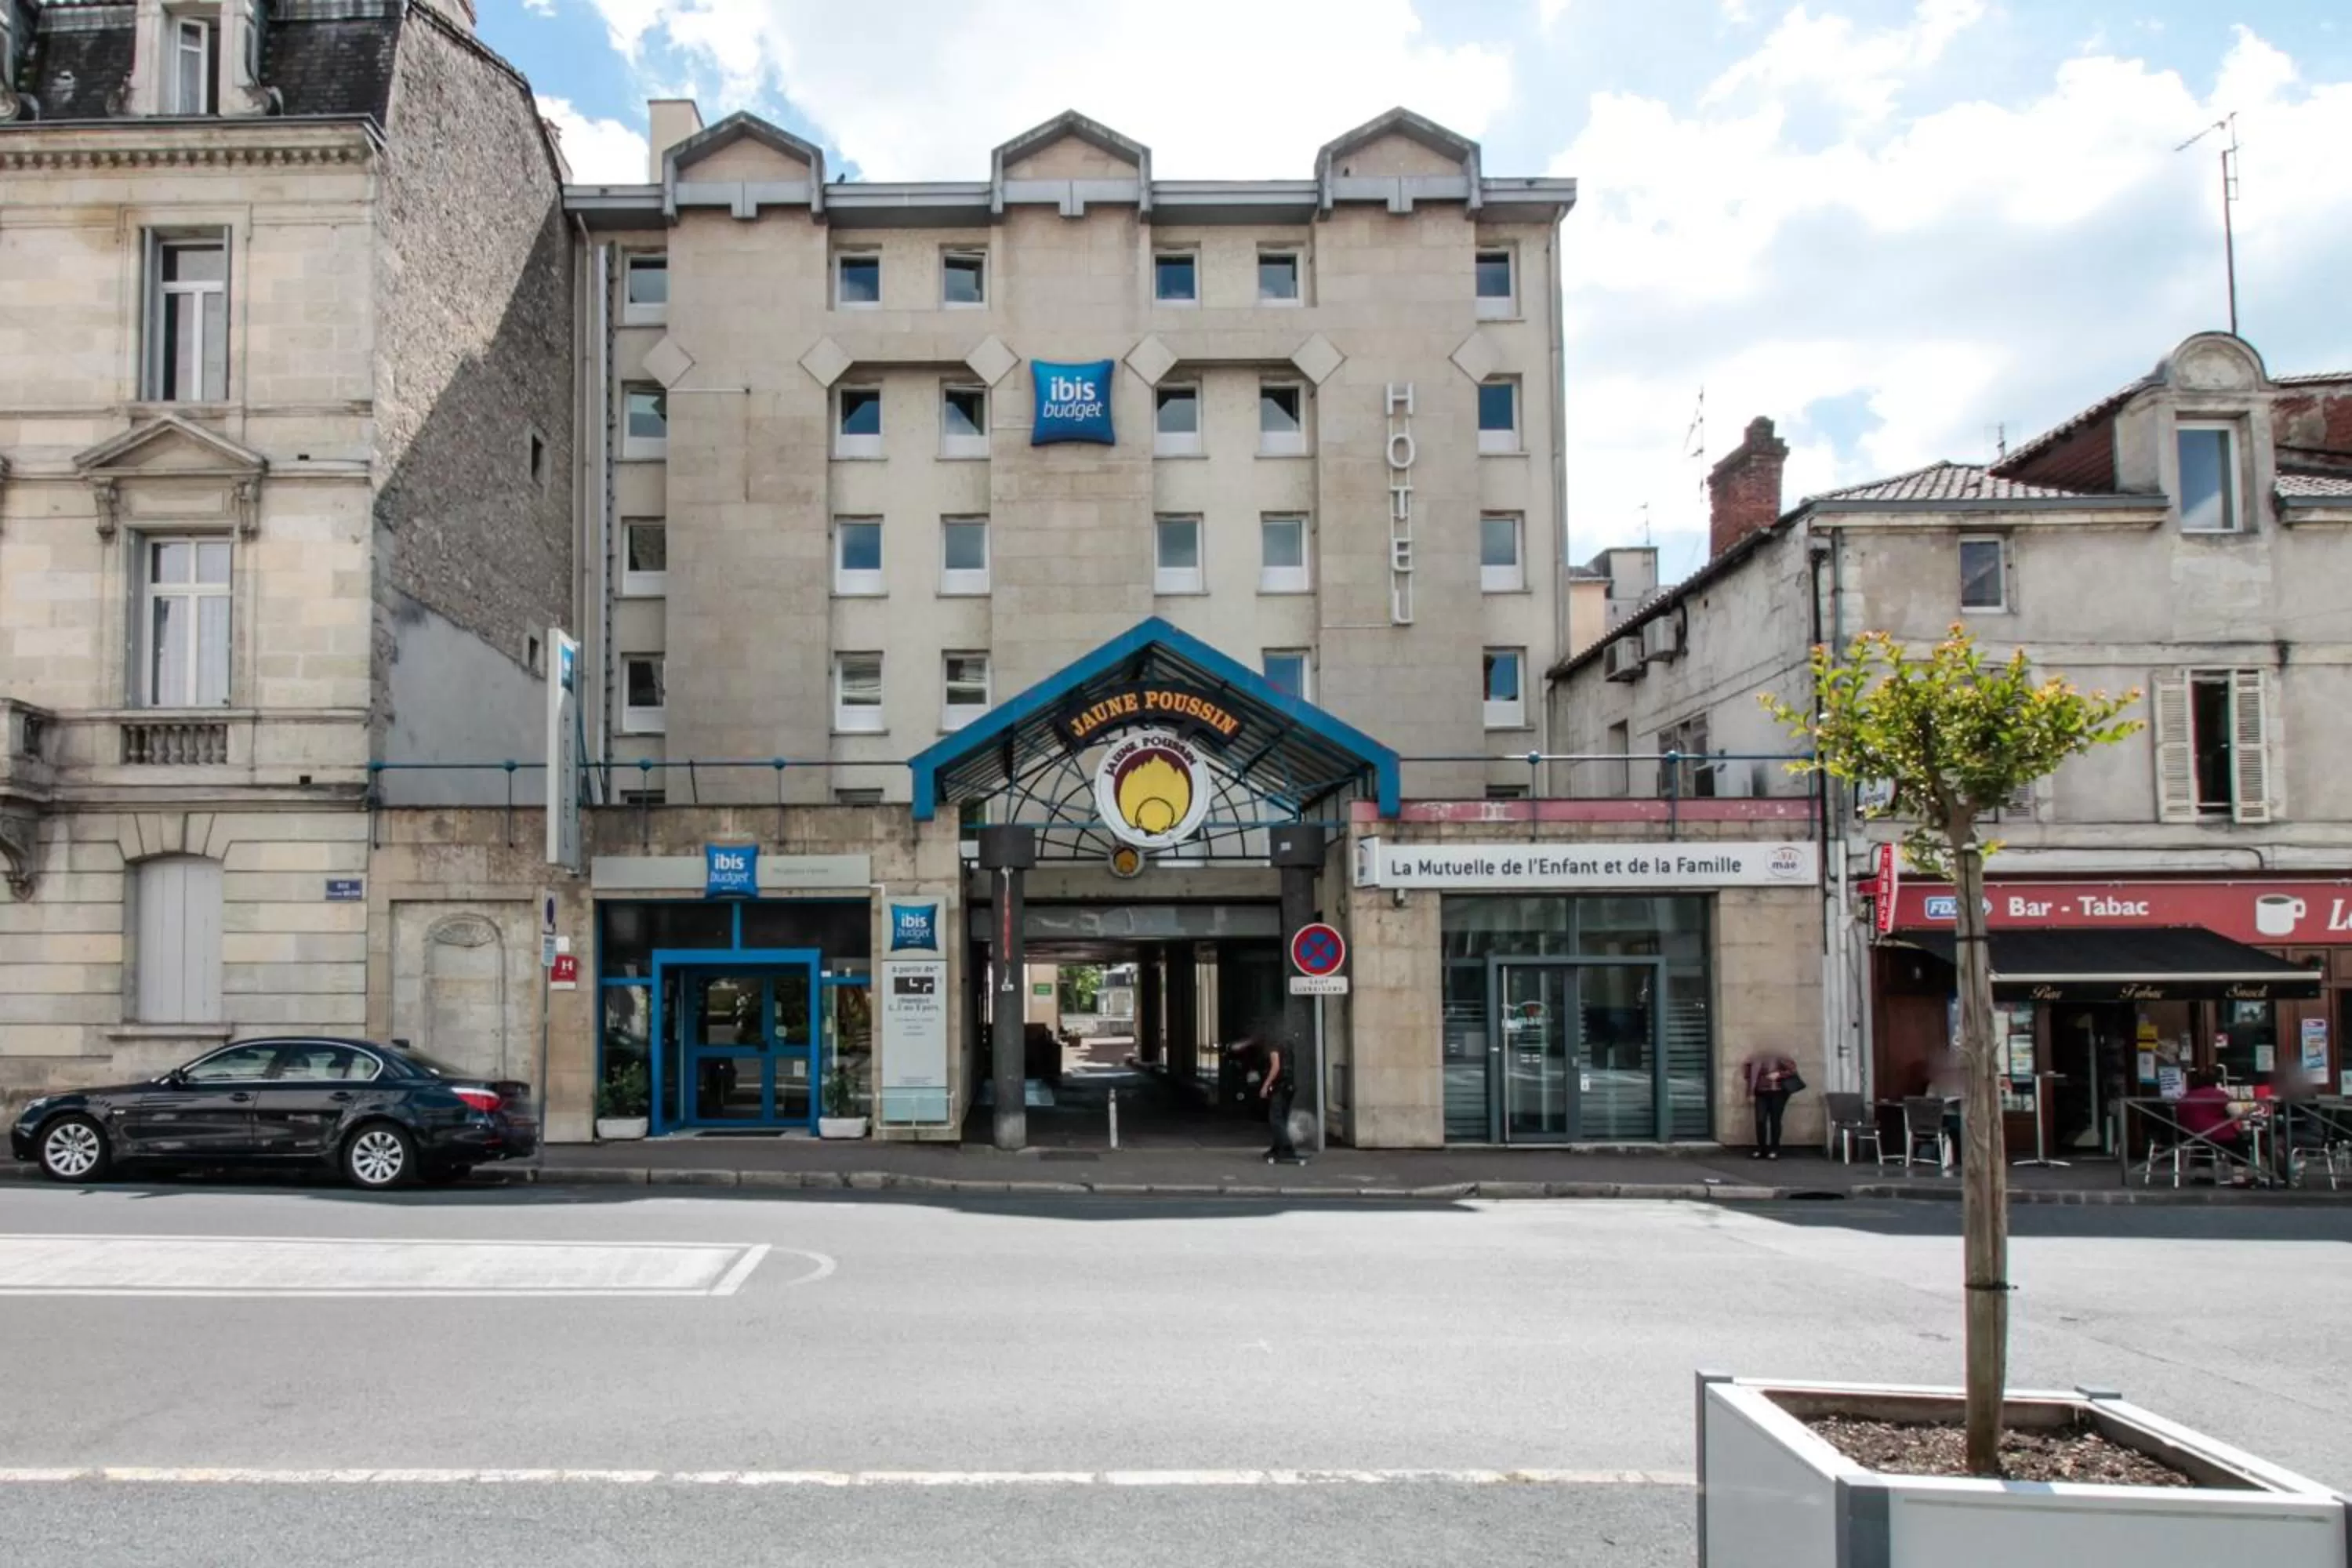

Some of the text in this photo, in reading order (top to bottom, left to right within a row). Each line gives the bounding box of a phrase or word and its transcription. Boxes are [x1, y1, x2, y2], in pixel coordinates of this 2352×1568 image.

[1050, 376, 1096, 401] ibis
[1043, 401, 1103, 422] budget
[1386, 382, 1415, 626] HOTEL
[1069, 690, 1242, 738] JAUNE POUSSIN
[714, 853, 746, 870] ibis
[1391, 856, 1743, 877] La Mutuelle de l'Enfant et de la Famille
[710, 870, 750, 885] budget
[2008, 896, 2053, 917] Bar
[2076, 895, 2151, 916] Tabac
[901, 913, 927, 928] ibis
[896, 927, 931, 940] budget
[561, 959, 574, 971] H
